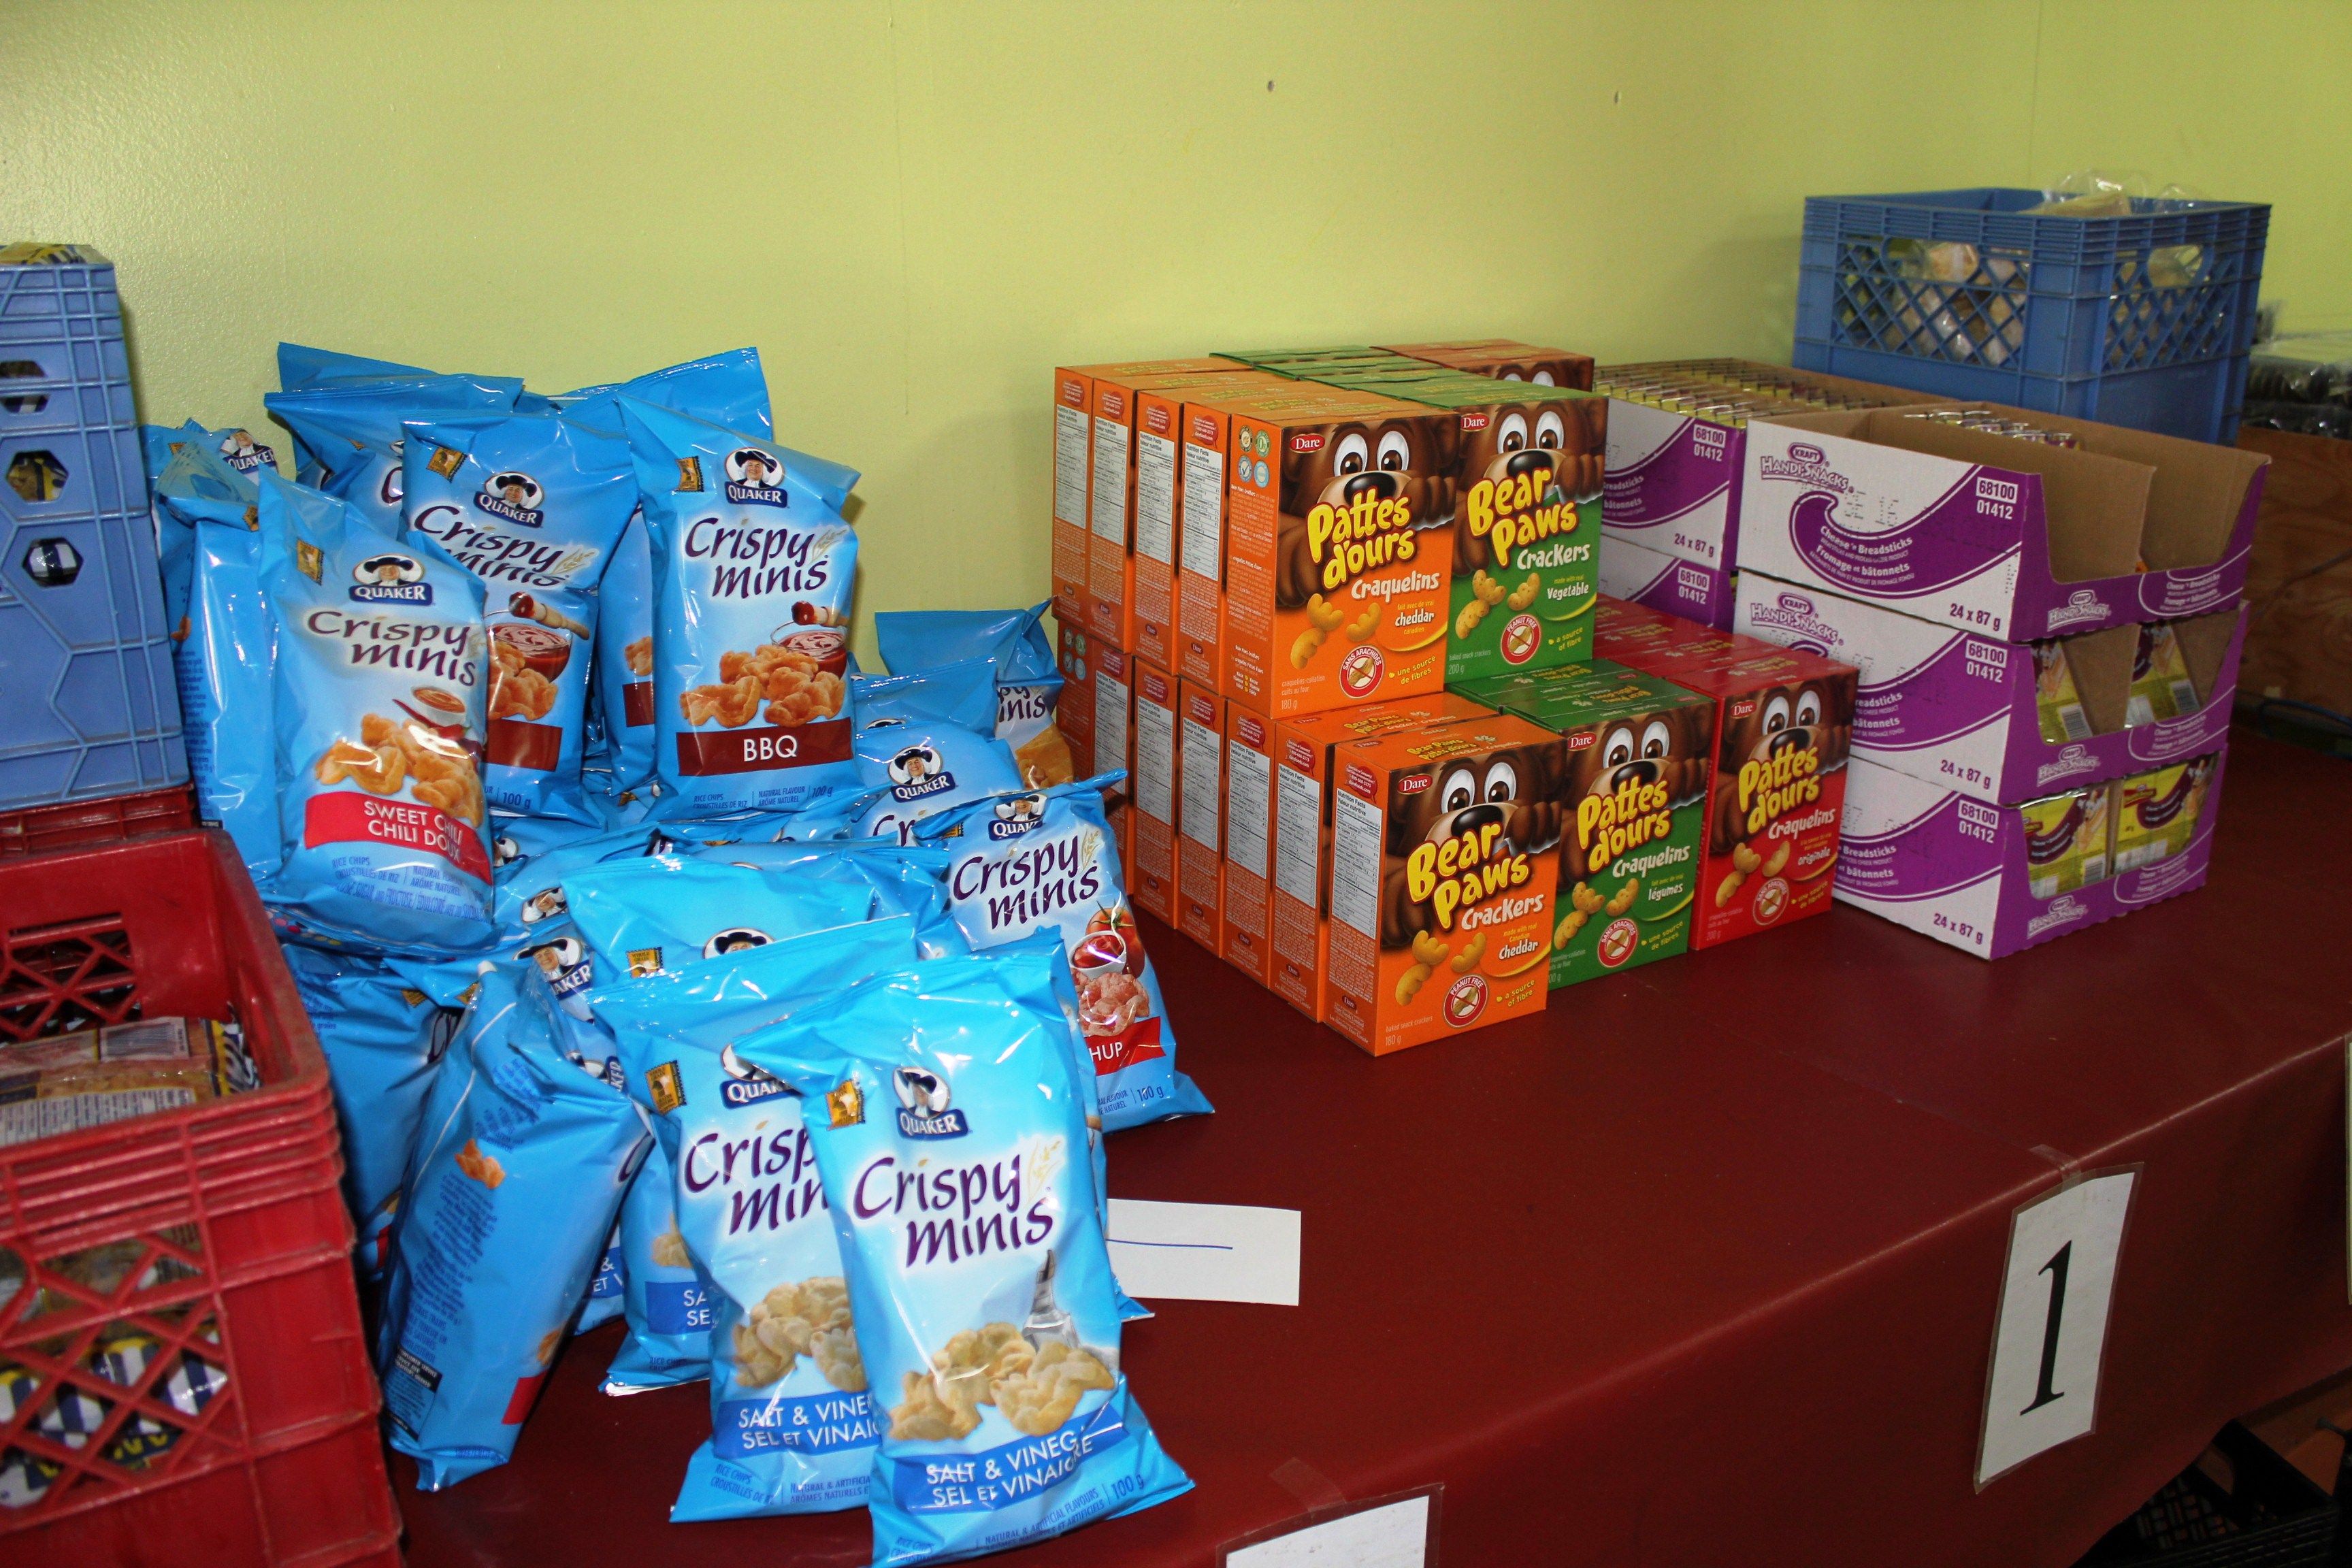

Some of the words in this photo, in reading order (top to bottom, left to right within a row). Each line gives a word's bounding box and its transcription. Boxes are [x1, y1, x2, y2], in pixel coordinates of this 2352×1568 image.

[1463, 416, 1485, 428] Dare
[1294, 437, 1320, 450] Dare
[1695, 427, 1724, 444] 68100
[1694, 445, 1722, 461] 01412
[1795, 448, 1818, 459] KRAFT
[728, 485, 781, 504] QUAKER
[1979, 480, 2015, 500] 68100
[478, 494, 538, 524] QUAKER
[1468, 468, 1551, 537] Bear
[1976, 500, 2013, 519] 01412
[1308, 489, 1410, 563] Pattes
[1492, 502, 1577, 567] Paws
[414, 506, 563, 573] Crispy
[685, 517, 815, 569] Crispy
[1674, 533, 1685, 546] 24
[1695, 539, 1706, 553] 87
[1708, 546, 1714, 558] g
[1858, 537, 1913, 555] Breadsticks
[1323, 530, 1415, 589] d'ours
[1517, 543, 1590, 570] Crackers
[1816, 544, 1852, 572] Fromage
[1861, 562, 1910, 576] bâtonnets
[712, 559, 828, 599] minis
[1351, 569, 1441, 603] Craquelins
[1680, 569, 1708, 588] 68100
[355, 585, 425, 602] QUAKER
[1547, 582, 1589, 600] Vegetable
[1678, 586, 1706, 604] 01412
[1784, 598, 1808, 611] KRAFT
[1395, 609, 1434, 627] cheddar
[1506, 617, 1526, 633] PEANUT
[1526, 617, 1537, 630] FREE
[1950, 603, 1964, 619] 24
[1966, 610, 1972, 621] x
[1976, 610, 1991, 625] 87
[1993, 618, 2001, 632] g
[308, 611, 470, 655] Crispy
[1561, 627, 1584, 641] source
[1343, 653, 1356, 671] SANS
[1356, 648, 1382, 666] ARACHIDES
[1967, 643, 2004, 664] 68100
[352, 644, 476, 687] minis
[1397, 666, 1410, 676] une
[1412, 655, 1437, 671] source
[1966, 662, 2003, 683] 01412
[1401, 676, 1410, 685] de
[1411, 668, 1432, 683] fibres
[1733, 702, 1753, 714] Dare
[1855, 692, 1903, 708] readsticks
[743, 735, 798, 762] BBQ
[1571, 735, 1592, 748] Dare
[1403, 777, 1427, 791] Dare
[1740, 742, 1818, 811] Pattes
[1940, 759, 1954, 775] 24
[1957, 766, 1964, 779] x
[1967, 768, 1981, 783] 87
[1984, 776, 1991, 789] g
[758, 789, 781, 798] NATURAL
[783, 786, 806, 795] FLAVOUR
[811, 786, 826, 798] 100
[894, 775, 949, 800] QUAKER
[503, 791, 521, 806] 100
[523, 799, 531, 810] g
[693, 795, 706, 803] RICE
[707, 794, 723, 802] CHIPS
[777, 796, 800, 804] NATUREL
[1337, 790, 1354, 803] Nutrition
[1354, 798, 1366, 808] Facts
[1748, 774, 1820, 834] d'ours
[363, 800, 427, 826] SWEET
[434, 814, 463, 846] CHILI
[1578, 776, 1667, 850] Pattes
[1961, 803, 1996, 825] 68100
[1768, 808, 1835, 840] Craquelins
[1959, 820, 1995, 844] 01412
[368, 819, 419, 843] CHILI
[423, 830, 461, 863] DOUX
[1588, 809, 1671, 872] d'ours
[1613, 845, 1690, 878] Craquelins
[1843, 845, 1897, 858] Breadsticks
[953, 835, 1079, 902] Crispy
[1407, 823, 1500, 902] Bear
[1846, 866, 1894, 878] bâtonnets
[988, 864, 1100, 930] minis
[1435, 853, 1529, 930] Paws
[1648, 883, 1684, 901] légumes
[1461, 893, 1544, 930] Crackers
[1662, 920, 1684, 936] source
[1933, 913, 1948, 928] 24
[1950, 921, 1956, 932] x
[1959, 922, 1973, 938] 87
[1976, 931, 1983, 945] g
[553, 964, 591, 995] AKER
[1450, 977, 1471, 996] PEANUT
[1471, 977, 1484, 990] FREE
[1510, 979, 1535, 997] source
[1344, 996, 1355, 1007] Dare
[1517, 990, 1533, 1004] fibre
[1386, 1035, 1395, 1045] 180
[1137, 1085, 1155, 1102] 100
[1156, 1085, 1164, 1098] g
[1105, 1100, 1127, 1114] NATUREL
[899, 1113, 960, 1136] QUAKER
[684, 1128, 815, 1193] Crisp
[853, 1153, 1021, 1220] Crispy
[729, 1178, 829, 1236] min
[905, 1196, 1055, 1269] minis
[600, 1257, 615, 1272] &
[593, 1277, 608, 1292] ET
[686, 1309, 710, 1327] SE
[2019, 1239, 2073, 1416] 1
[738, 1406, 783, 1428] SALT
[792, 1405, 808, 1426] &
[815, 1394, 870, 1422] VINE
[741, 1431, 779, 1450] SEL
[783, 1432, 800, 1446] ET
[806, 1420, 879, 1448] VINAI
[926, 1461, 976, 1485] SALT
[985, 1458, 1002, 1480] &
[1006, 1428, 1081, 1471] VINEG
[715, 1463, 730, 1476] RICE
[730, 1467, 753, 1484] CHIPS
[835, 1475, 870, 1487] ARTIFICIA
[824, 1488, 862, 1499] NATURELS
[932, 1486, 972, 1507] SEL
[977, 1486, 996, 1501] ET
[1111, 1476, 1133, 1499] 100
[1137, 1473, 1145, 1490] g
[985, 1529, 1020, 1545] NATURAL
[1031, 1509, 1066, 1532] ARTIFICIAL
[1064, 1488, 1100, 1515] FLAVOURS
[1067, 1499, 1105, 1526] ARTIFICIELS
